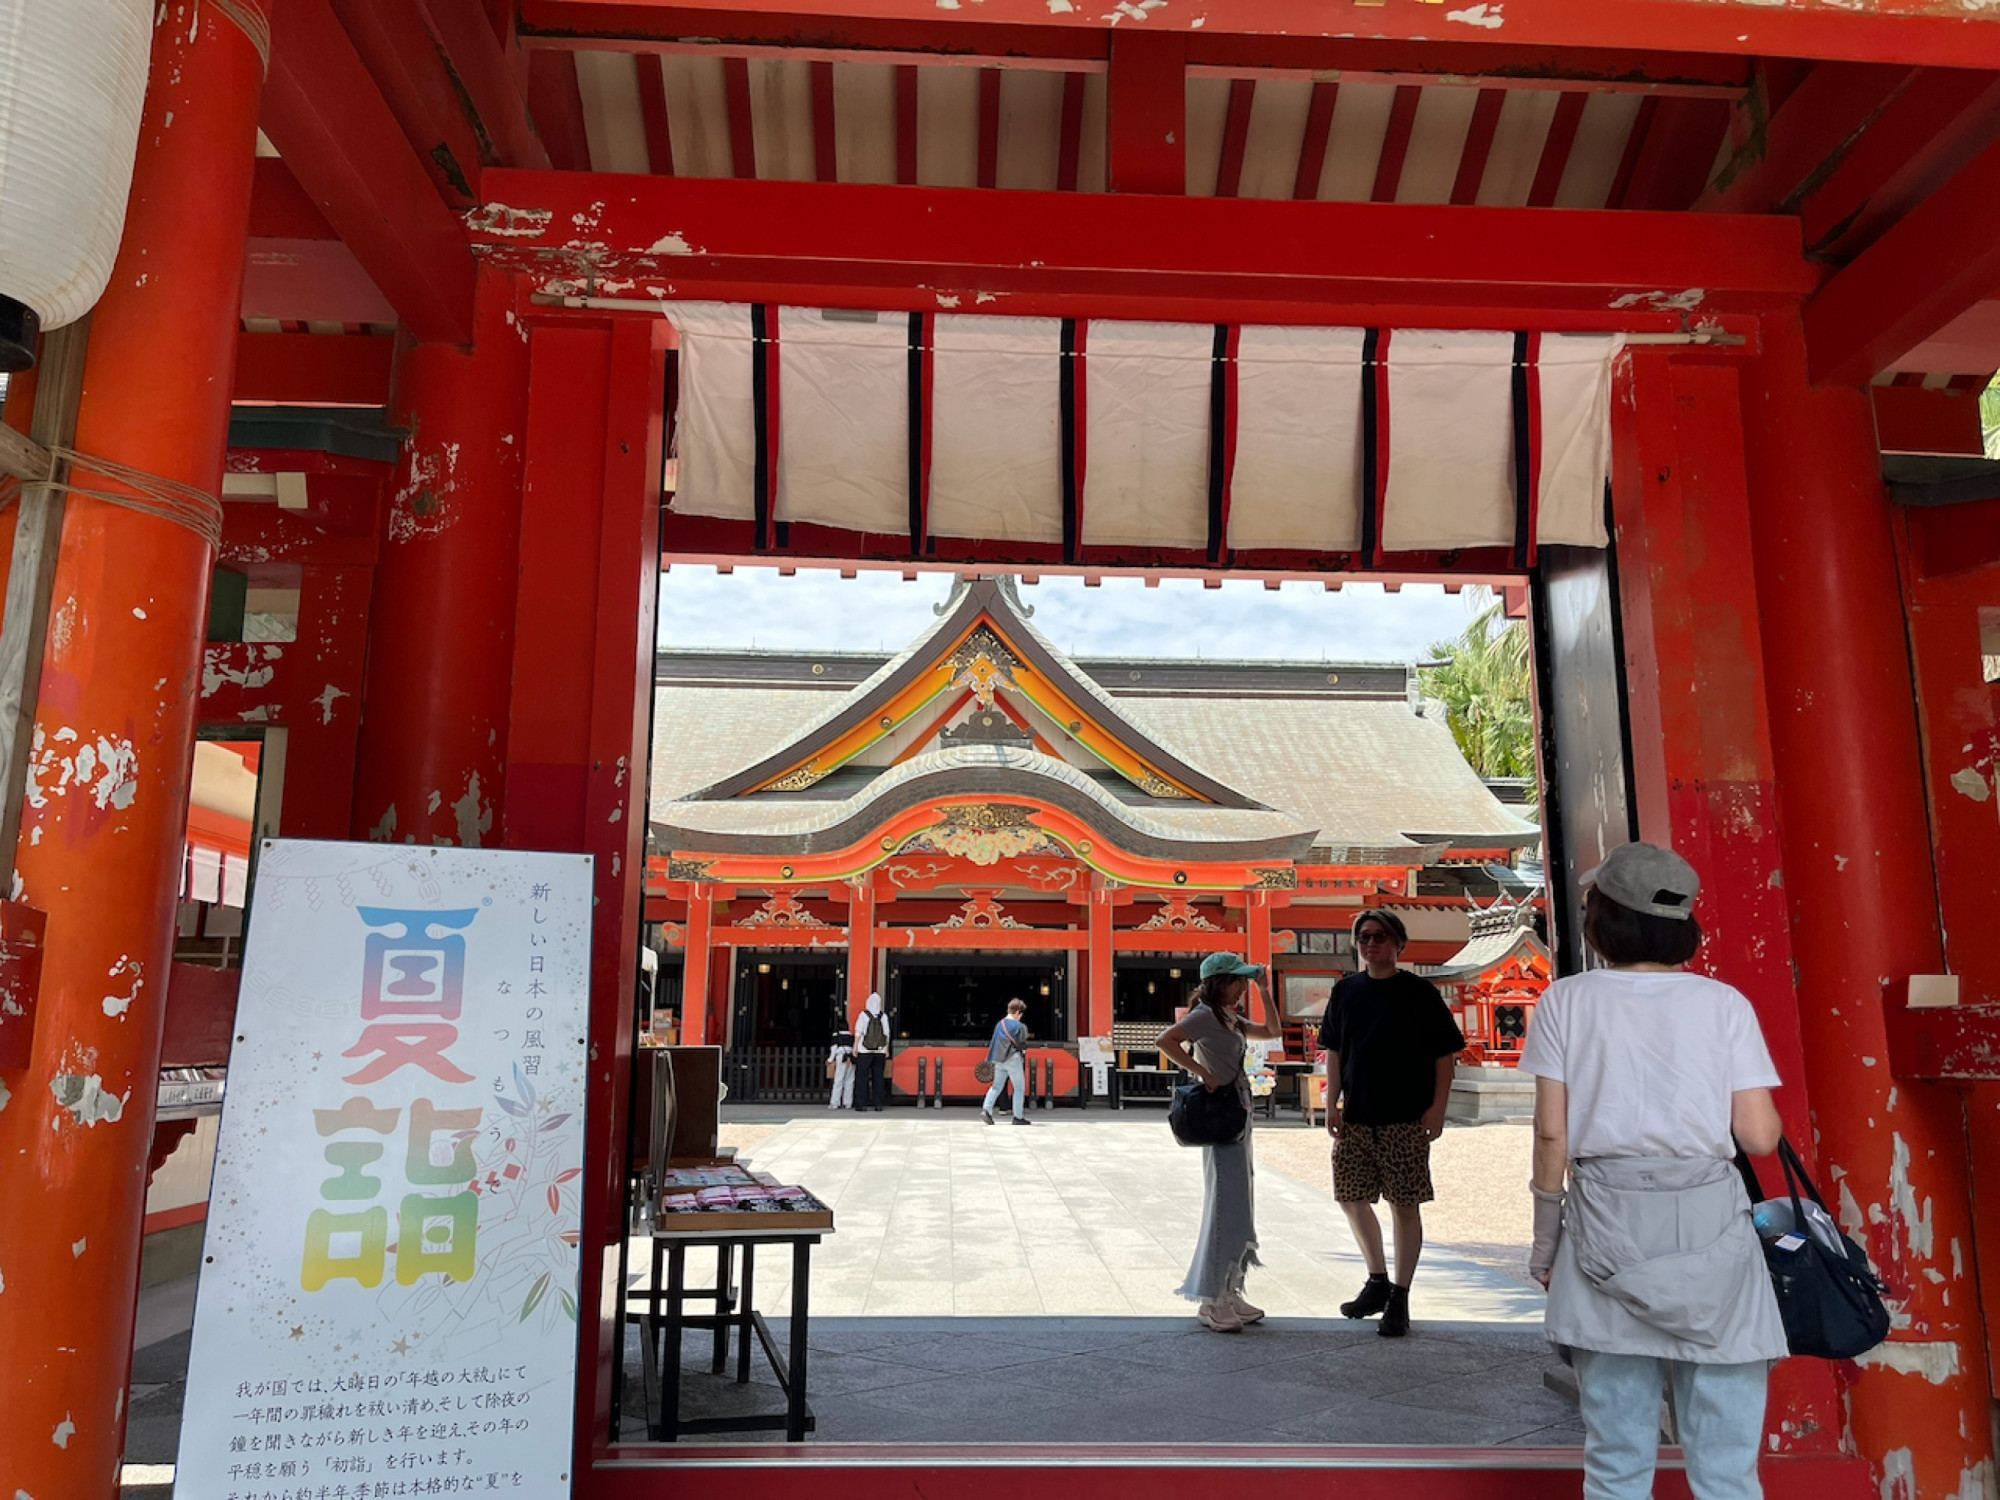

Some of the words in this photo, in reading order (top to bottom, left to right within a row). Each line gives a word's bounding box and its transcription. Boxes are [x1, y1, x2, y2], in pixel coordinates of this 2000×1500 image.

[484, 979, 512, 1195] なつもうで
[521, 882, 552, 1076] 新しい日本の風習
[301, 905, 483, 1292] 夏詣
